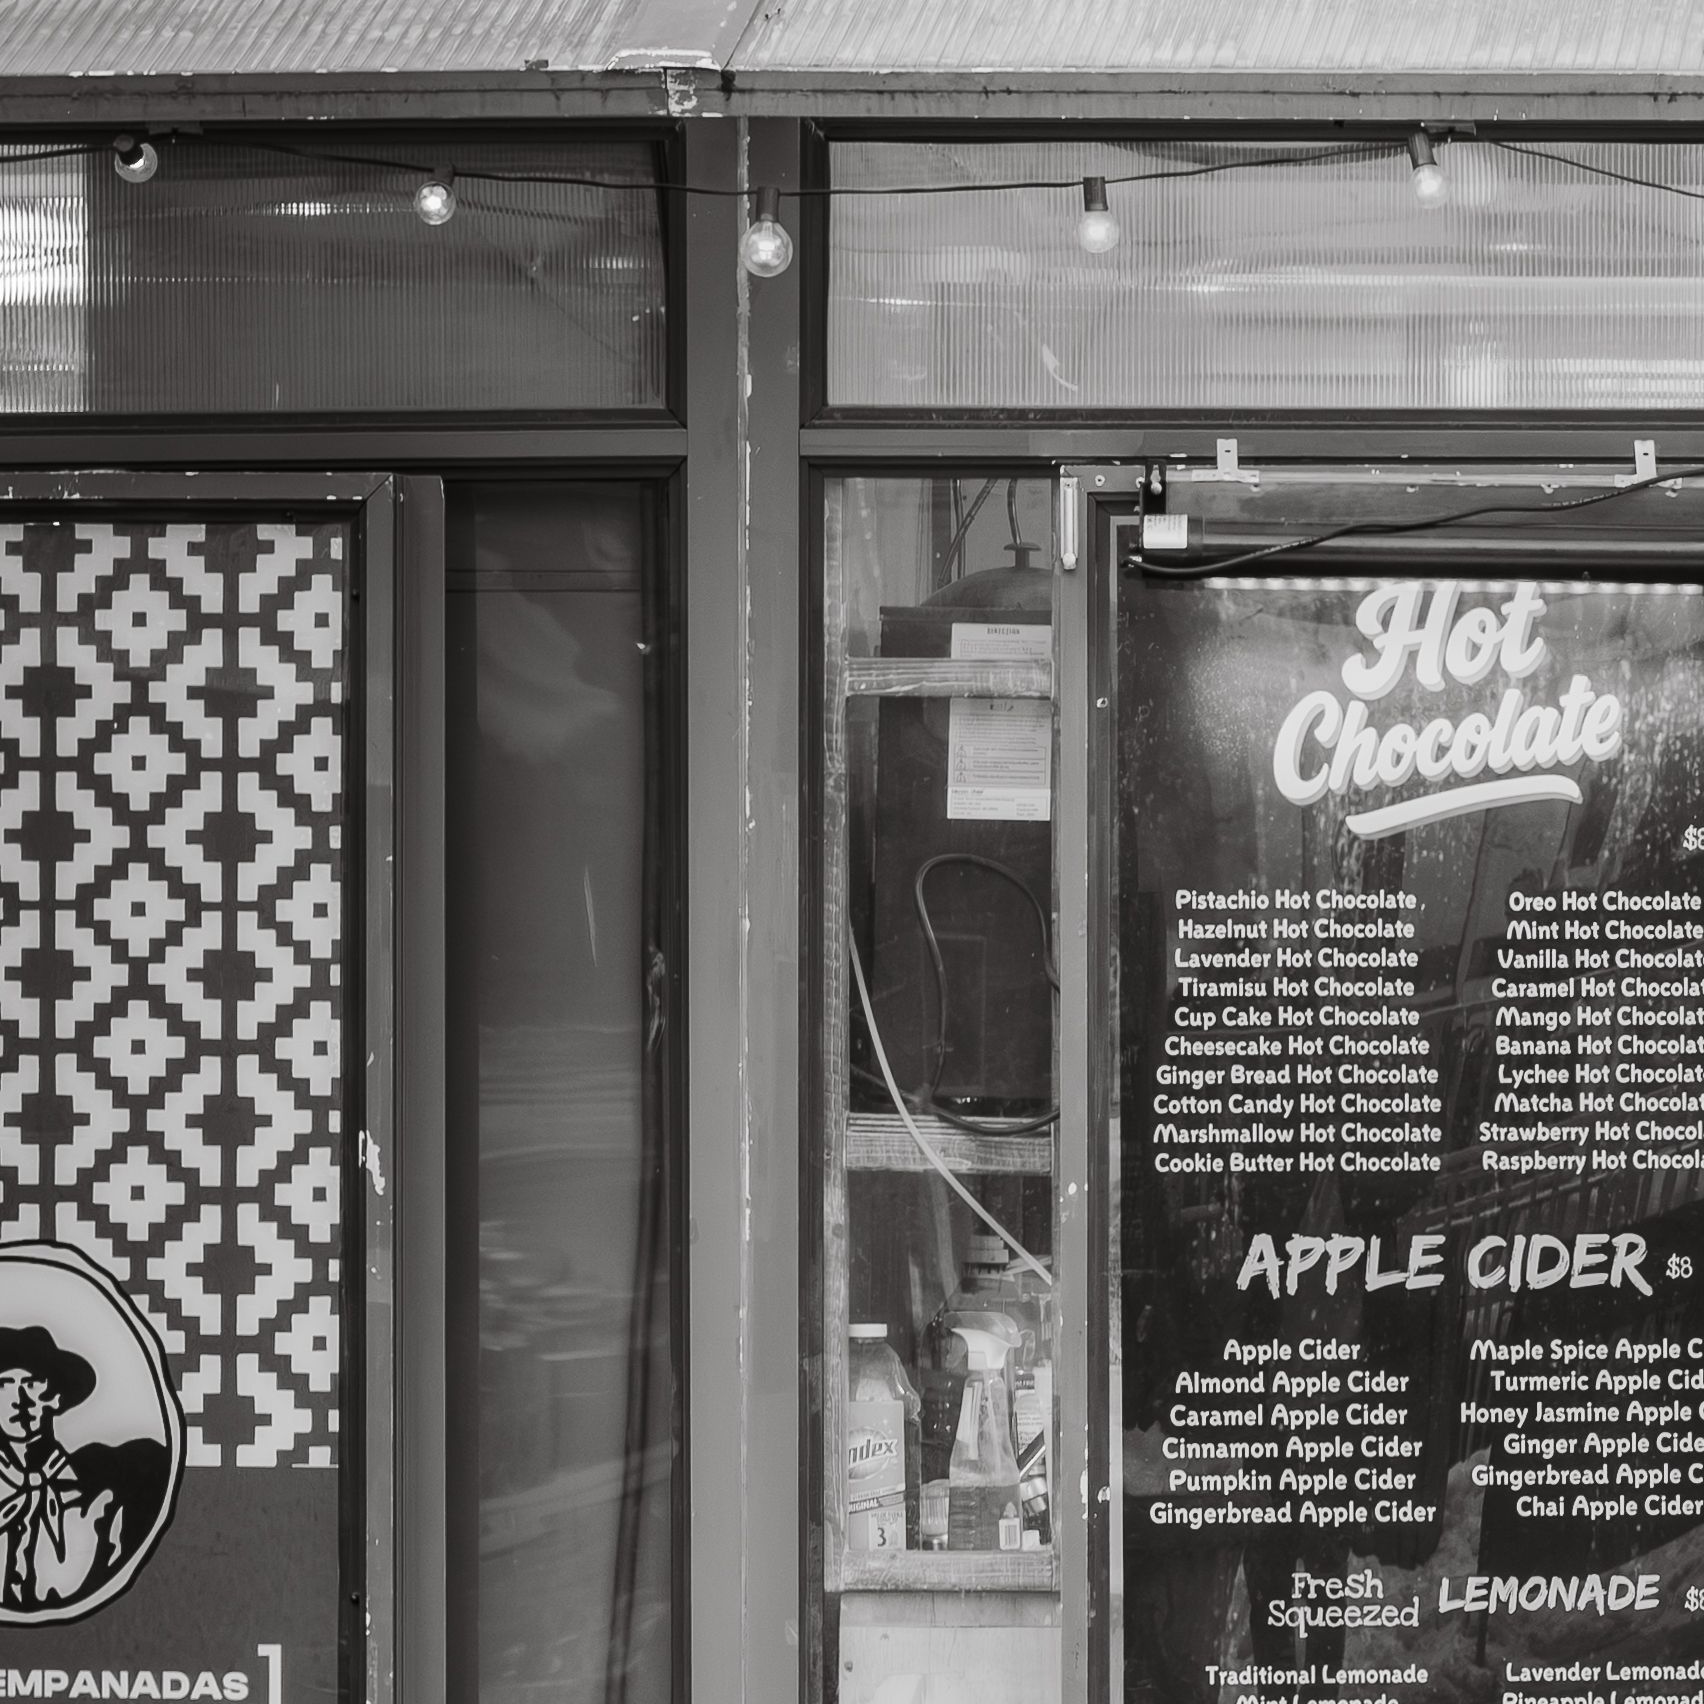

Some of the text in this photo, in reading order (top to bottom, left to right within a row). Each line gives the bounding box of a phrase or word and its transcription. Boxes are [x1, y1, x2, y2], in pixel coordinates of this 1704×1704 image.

[1342, 582, 1547, 700] Hot
[1273, 674, 1622, 804] Chocolate
[1175, 888, 1417, 910] Pistachio Hot Chocolate
[1508, 890, 1702, 912] Oreo Hot Chocolate
[1497, 948, 1570, 969] Vanilla
[1575, 948, 1610, 969] Hot
[1174, 1005, 1420, 1031] Cup Cake Hot Chocolate
[1479, 1121, 1590, 1147] Strawberry
[1595, 1120, 1631, 1141] Hot
[1236, 1232, 1693, 1300] APPLE CIDER $8
[1460, 1401, 1529, 1429] Honey
[1534, 1401, 1620, 1423] Jasmine
[1626, 1399, 1692, 1426] Apple
[1162, 1435, 1423, 1463] Cinnamon Apple Cider
[1291, 1568, 1384, 1600] Fresh
[1438, 1573, 1661, 1617] LEMONADE
[1267, 1595, 1420, 1639] Squeezed
[0, 1668, 249, 1701] MPANADAS
[1205, 1663, 1429, 1687] Traditional Lemonade
